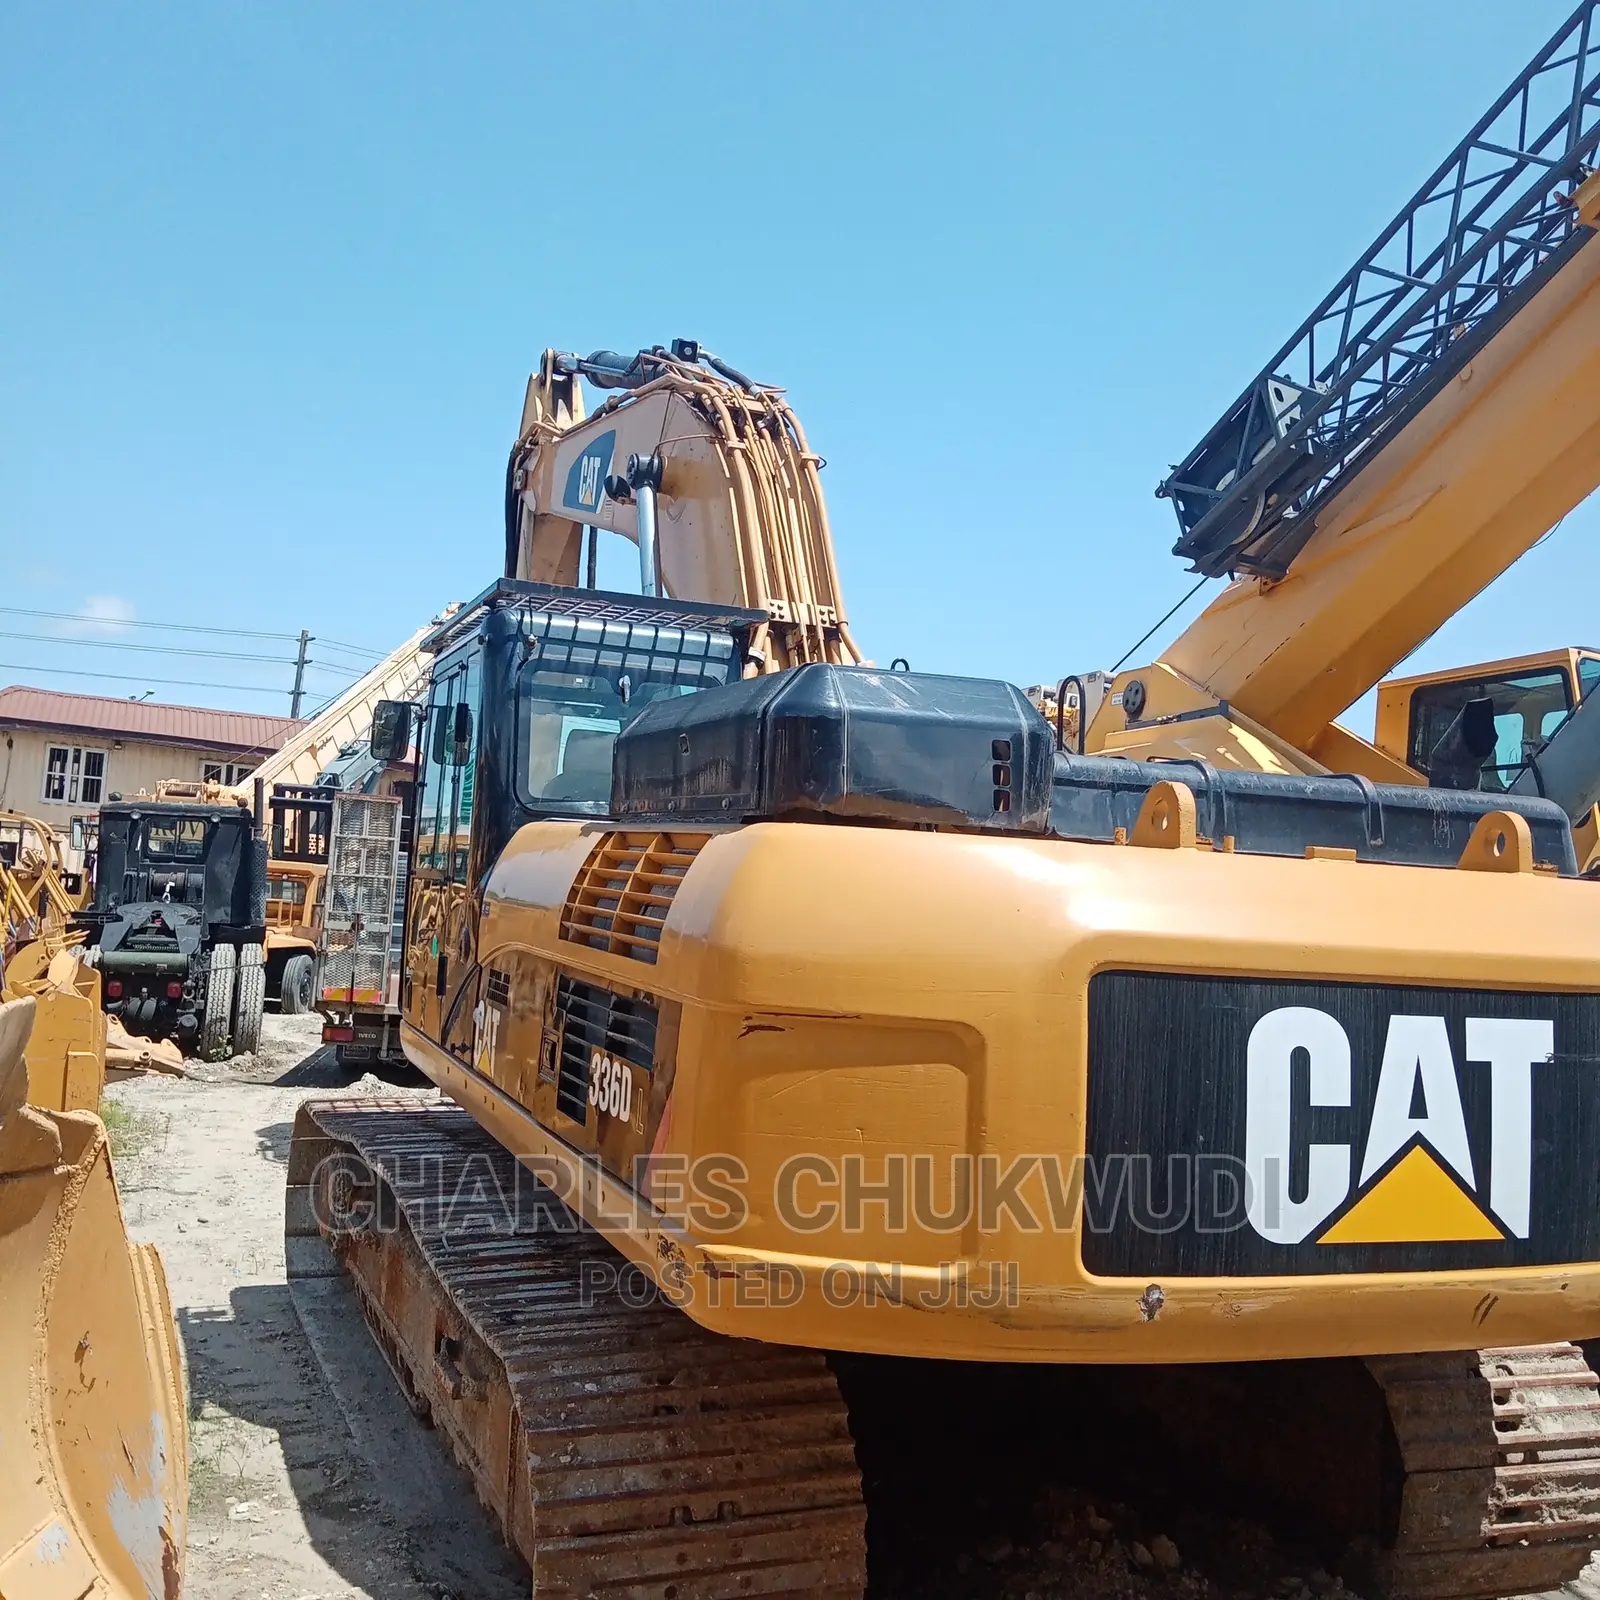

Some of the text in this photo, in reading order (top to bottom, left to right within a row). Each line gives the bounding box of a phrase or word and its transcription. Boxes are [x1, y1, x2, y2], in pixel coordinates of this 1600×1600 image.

[579, 455, 601, 505] CAT
[473, 1000, 500, 1079] CAT
[589, 1052, 632, 1122] 336D
[1246, 1006, 1554, 1244] CAT
